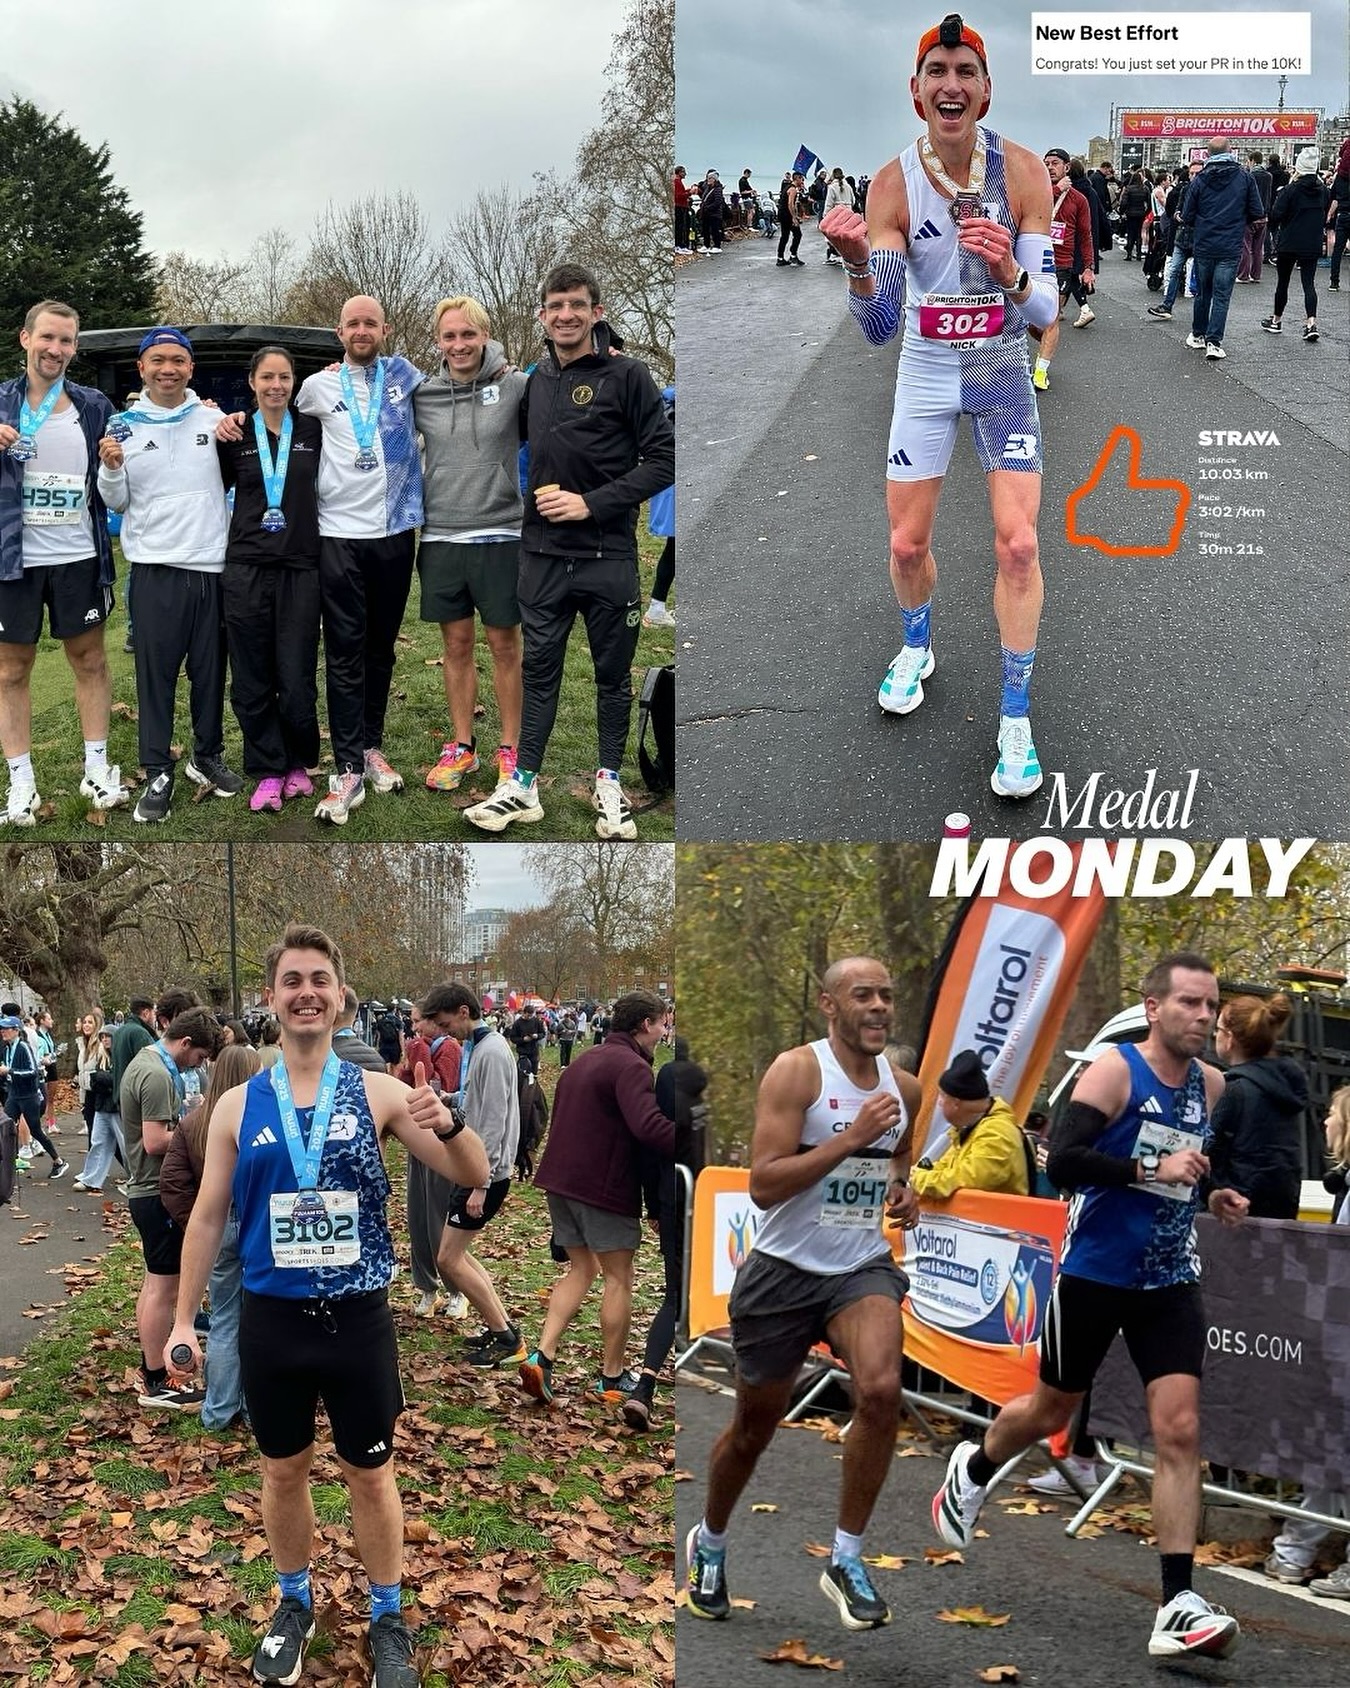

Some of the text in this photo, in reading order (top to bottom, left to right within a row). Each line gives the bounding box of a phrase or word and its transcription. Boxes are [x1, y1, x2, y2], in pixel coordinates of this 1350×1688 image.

[1051, 228, 1062, 238] 72
[937, 312, 989, 335] 302
[950, 341, 976, 349] NICK
[22, 488, 83, 508] 4357
[974, 944, 1032, 1070] oltarol
[311, 1124, 324, 1152] 2025
[827, 1180, 887, 1205] 1047
[275, 1215, 354, 1243] 3102
[913, 1227, 957, 1259] Voltarol
[1206, 1326, 1303, 1365] OES.COM
